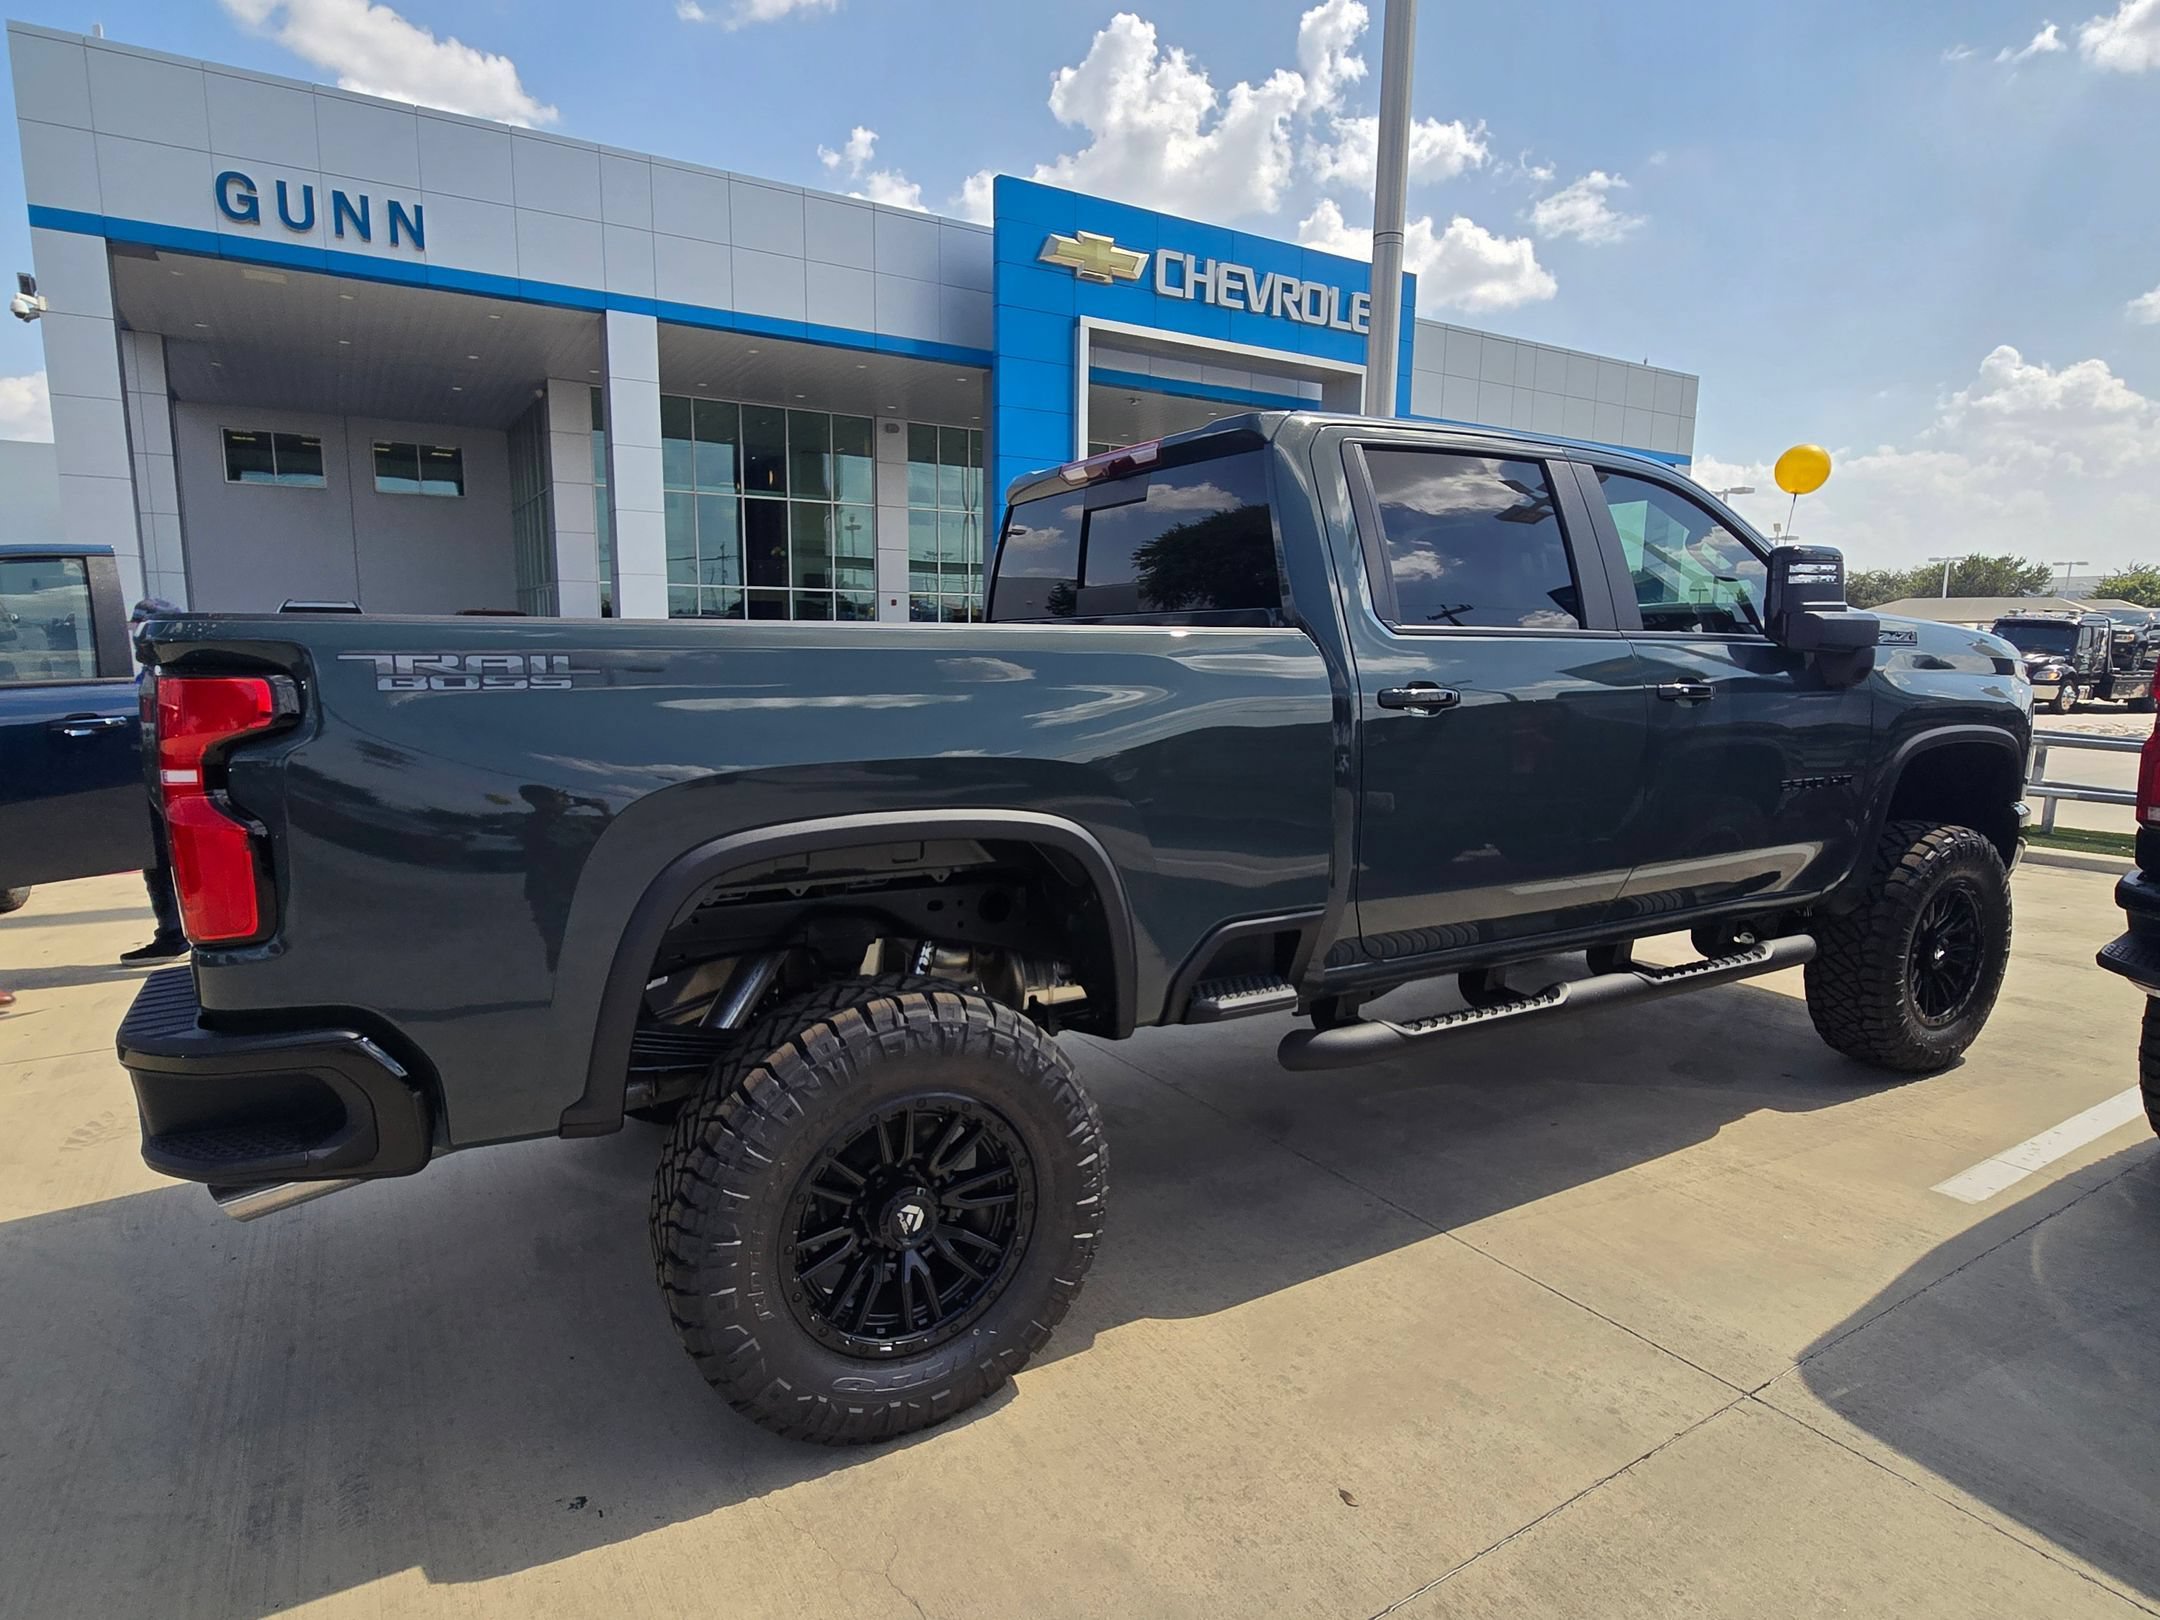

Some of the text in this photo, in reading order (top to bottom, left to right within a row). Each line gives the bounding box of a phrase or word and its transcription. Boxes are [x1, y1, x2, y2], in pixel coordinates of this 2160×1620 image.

[215, 171, 425, 250] GUNN
[1156, 249, 1371, 334] CHEVROLE
[337, 654, 570, 674] TRAIL
[375, 674, 573, 691] BOSS
